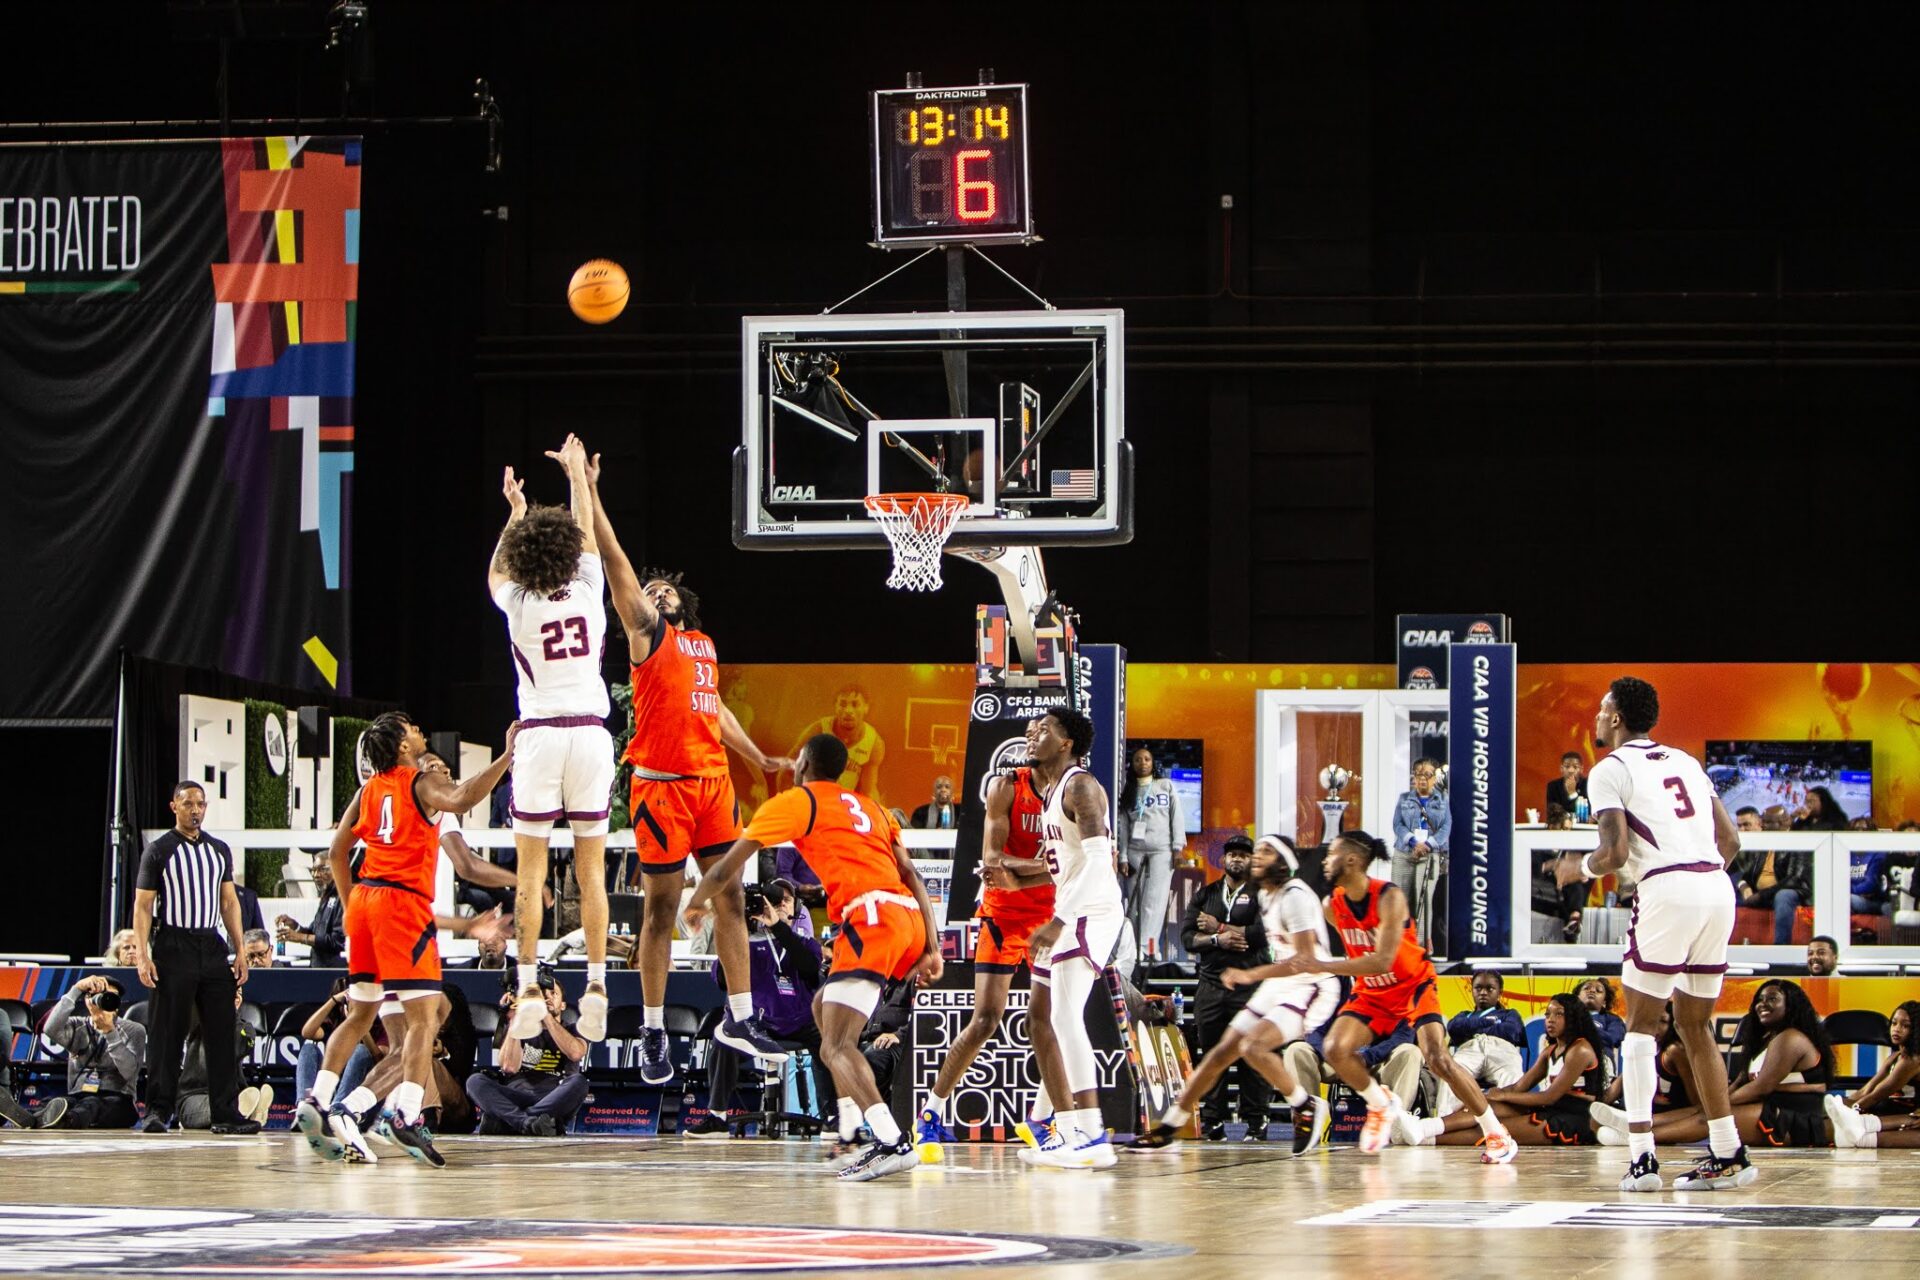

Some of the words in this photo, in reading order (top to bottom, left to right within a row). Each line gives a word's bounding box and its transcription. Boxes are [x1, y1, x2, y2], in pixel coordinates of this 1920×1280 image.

[915, 90, 987, 100] DAKTRONICS
[909, 106, 1009, 146] 13:14
[956, 149, 996, 220] 6
[0, 196, 142, 273] EBRATED
[773, 485, 817, 501] CIAA
[757, 523, 794, 533] SPALDING
[541, 616, 590, 661] 23
[1403, 630, 1451, 647] CIAA
[695, 661, 715, 688] 32
[1472, 655, 1490, 701] CIAA
[691, 690, 718, 714] STATE
[1006, 696, 1032, 707] CFG
[1034, 695, 1067, 706] BANK
[1016, 707, 1048, 718] AREN
[1472, 706, 1489, 739] VIP
[1472, 740, 1489, 864] HOSPITALITY
[1662, 776, 1696, 820] 3
[376, 795, 395, 845] 4
[840, 793, 872, 833] 3
[917, 864, 950, 874] edential
[1471, 866, 1488, 946] LOUNGE
[583, 1117, 652, 1126] Commissioner
[588, 1107, 634, 1116] Reserved
[635, 1107, 650, 1116] for
[1334, 1124, 1353, 1132] Ball
